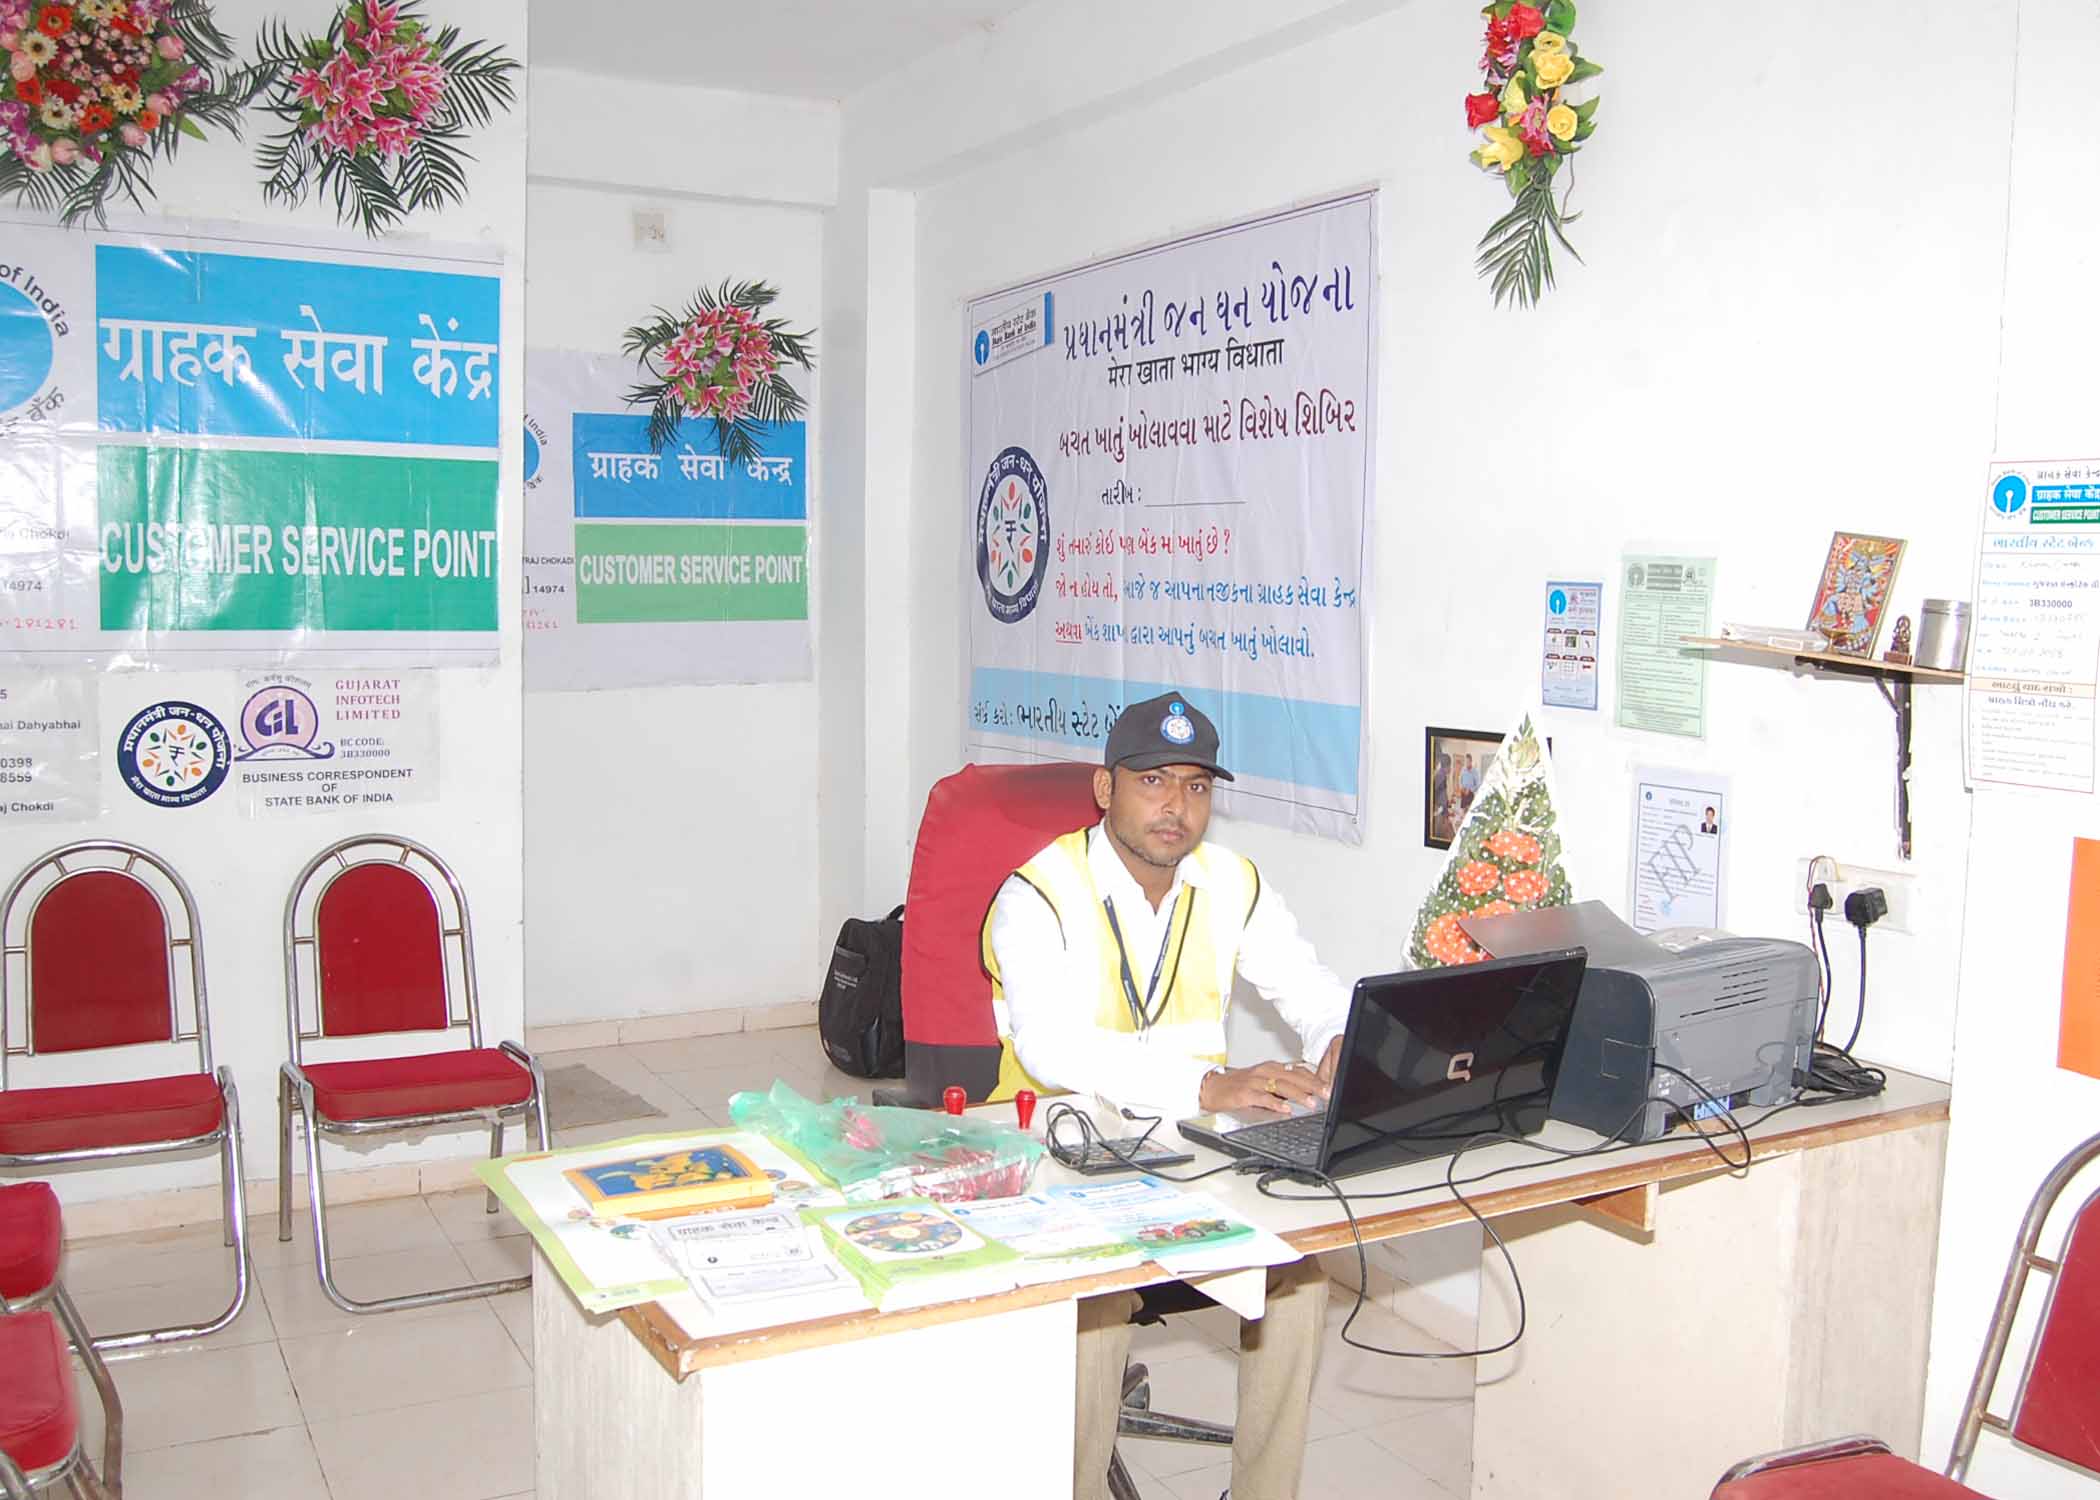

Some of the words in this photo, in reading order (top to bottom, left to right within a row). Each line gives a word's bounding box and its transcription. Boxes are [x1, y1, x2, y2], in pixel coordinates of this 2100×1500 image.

[24, 276, 69, 337] India
[1064, 289, 1155, 361] પ્રધાનમંત્રી
[1164, 295, 1207, 338] જન
[1217, 286, 1251, 332] ધન
[1261, 261, 1354, 323] યોજના
[99, 317, 257, 388] ग्राहक
[281, 304, 388, 395] सेवा
[411, 313, 498, 400] केंद्र
[1108, 356, 1131, 388] मेरा
[1136, 356, 1176, 385] खाता
[1181, 349, 1220, 377] भाग्य
[1226, 336, 1285, 372] विधाता
[528, 418, 548, 446] India
[1059, 430, 1090, 458] બચત
[1095, 415, 1125, 463] ખાતું
[1129, 409, 1197, 450] ખોલાવવા
[1203, 399, 1232, 443] માટે
[1240, 394, 1288, 441] વિશેષ
[1296, 388, 1355, 436] શિબિર
[587, 452, 661, 483] ग्राहक
[677, 443, 727, 481] सेवा
[101, 521, 274, 575] CUSTOMER
[282, 525, 405, 577] SERVICE
[413, 528, 498, 578] POINT
[1179, 529, 1203, 562] ખાતું
[579, 554, 677, 585] CUSTOMER
[680, 554, 750, 585] SERVICE
[755, 555, 804, 585] POINT
[533, 585, 565, 594] 14974
[1298, 576, 1327, 607] સેવા
[335, 679, 401, 691] GUJARAT
[335, 694, 401, 705] INFOTECH
[17, 720, 81, 732] Dahyabhai
[335, 709, 401, 721] LIMITED
[1016, 697, 1067, 736] ભારતીય
[0, 757, 33, 769] 0398
[242, 772, 304, 784] BUSINESS
[307, 769, 414, 782] CORRESPONDENT
[265, 796, 302, 808] STATE
[306, 795, 340, 806] BANK
[343, 794, 359, 804] OF
[362, 793, 394, 803] INDIA
[321, 783, 338, 793] OF
[11, 801, 54, 813] Chokdi
